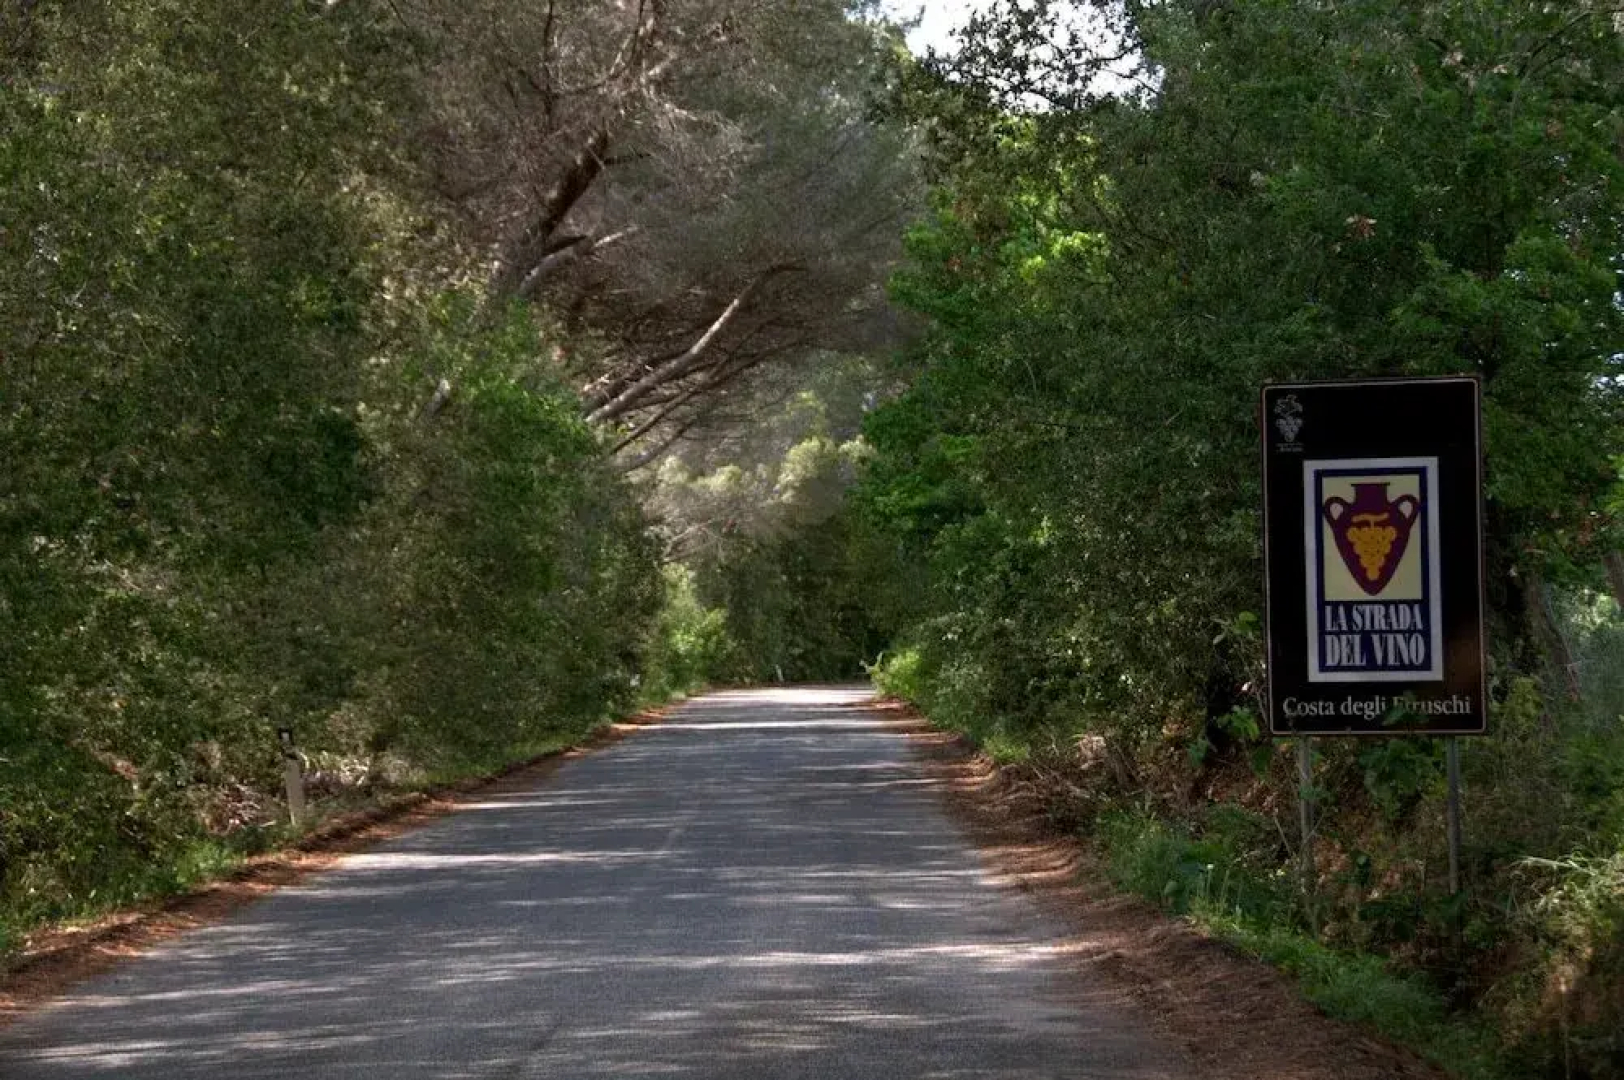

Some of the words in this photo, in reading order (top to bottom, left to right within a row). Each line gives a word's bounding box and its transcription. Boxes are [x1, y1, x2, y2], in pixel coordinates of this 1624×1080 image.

[1324, 604, 1348, 630] LA
[1352, 604, 1424, 630] STRADA
[1325, 634, 1367, 667] DEL
[1370, 633, 1425, 667] VINO
[1282, 696, 1336, 716] Costa
[1340, 695, 1387, 720] degli
